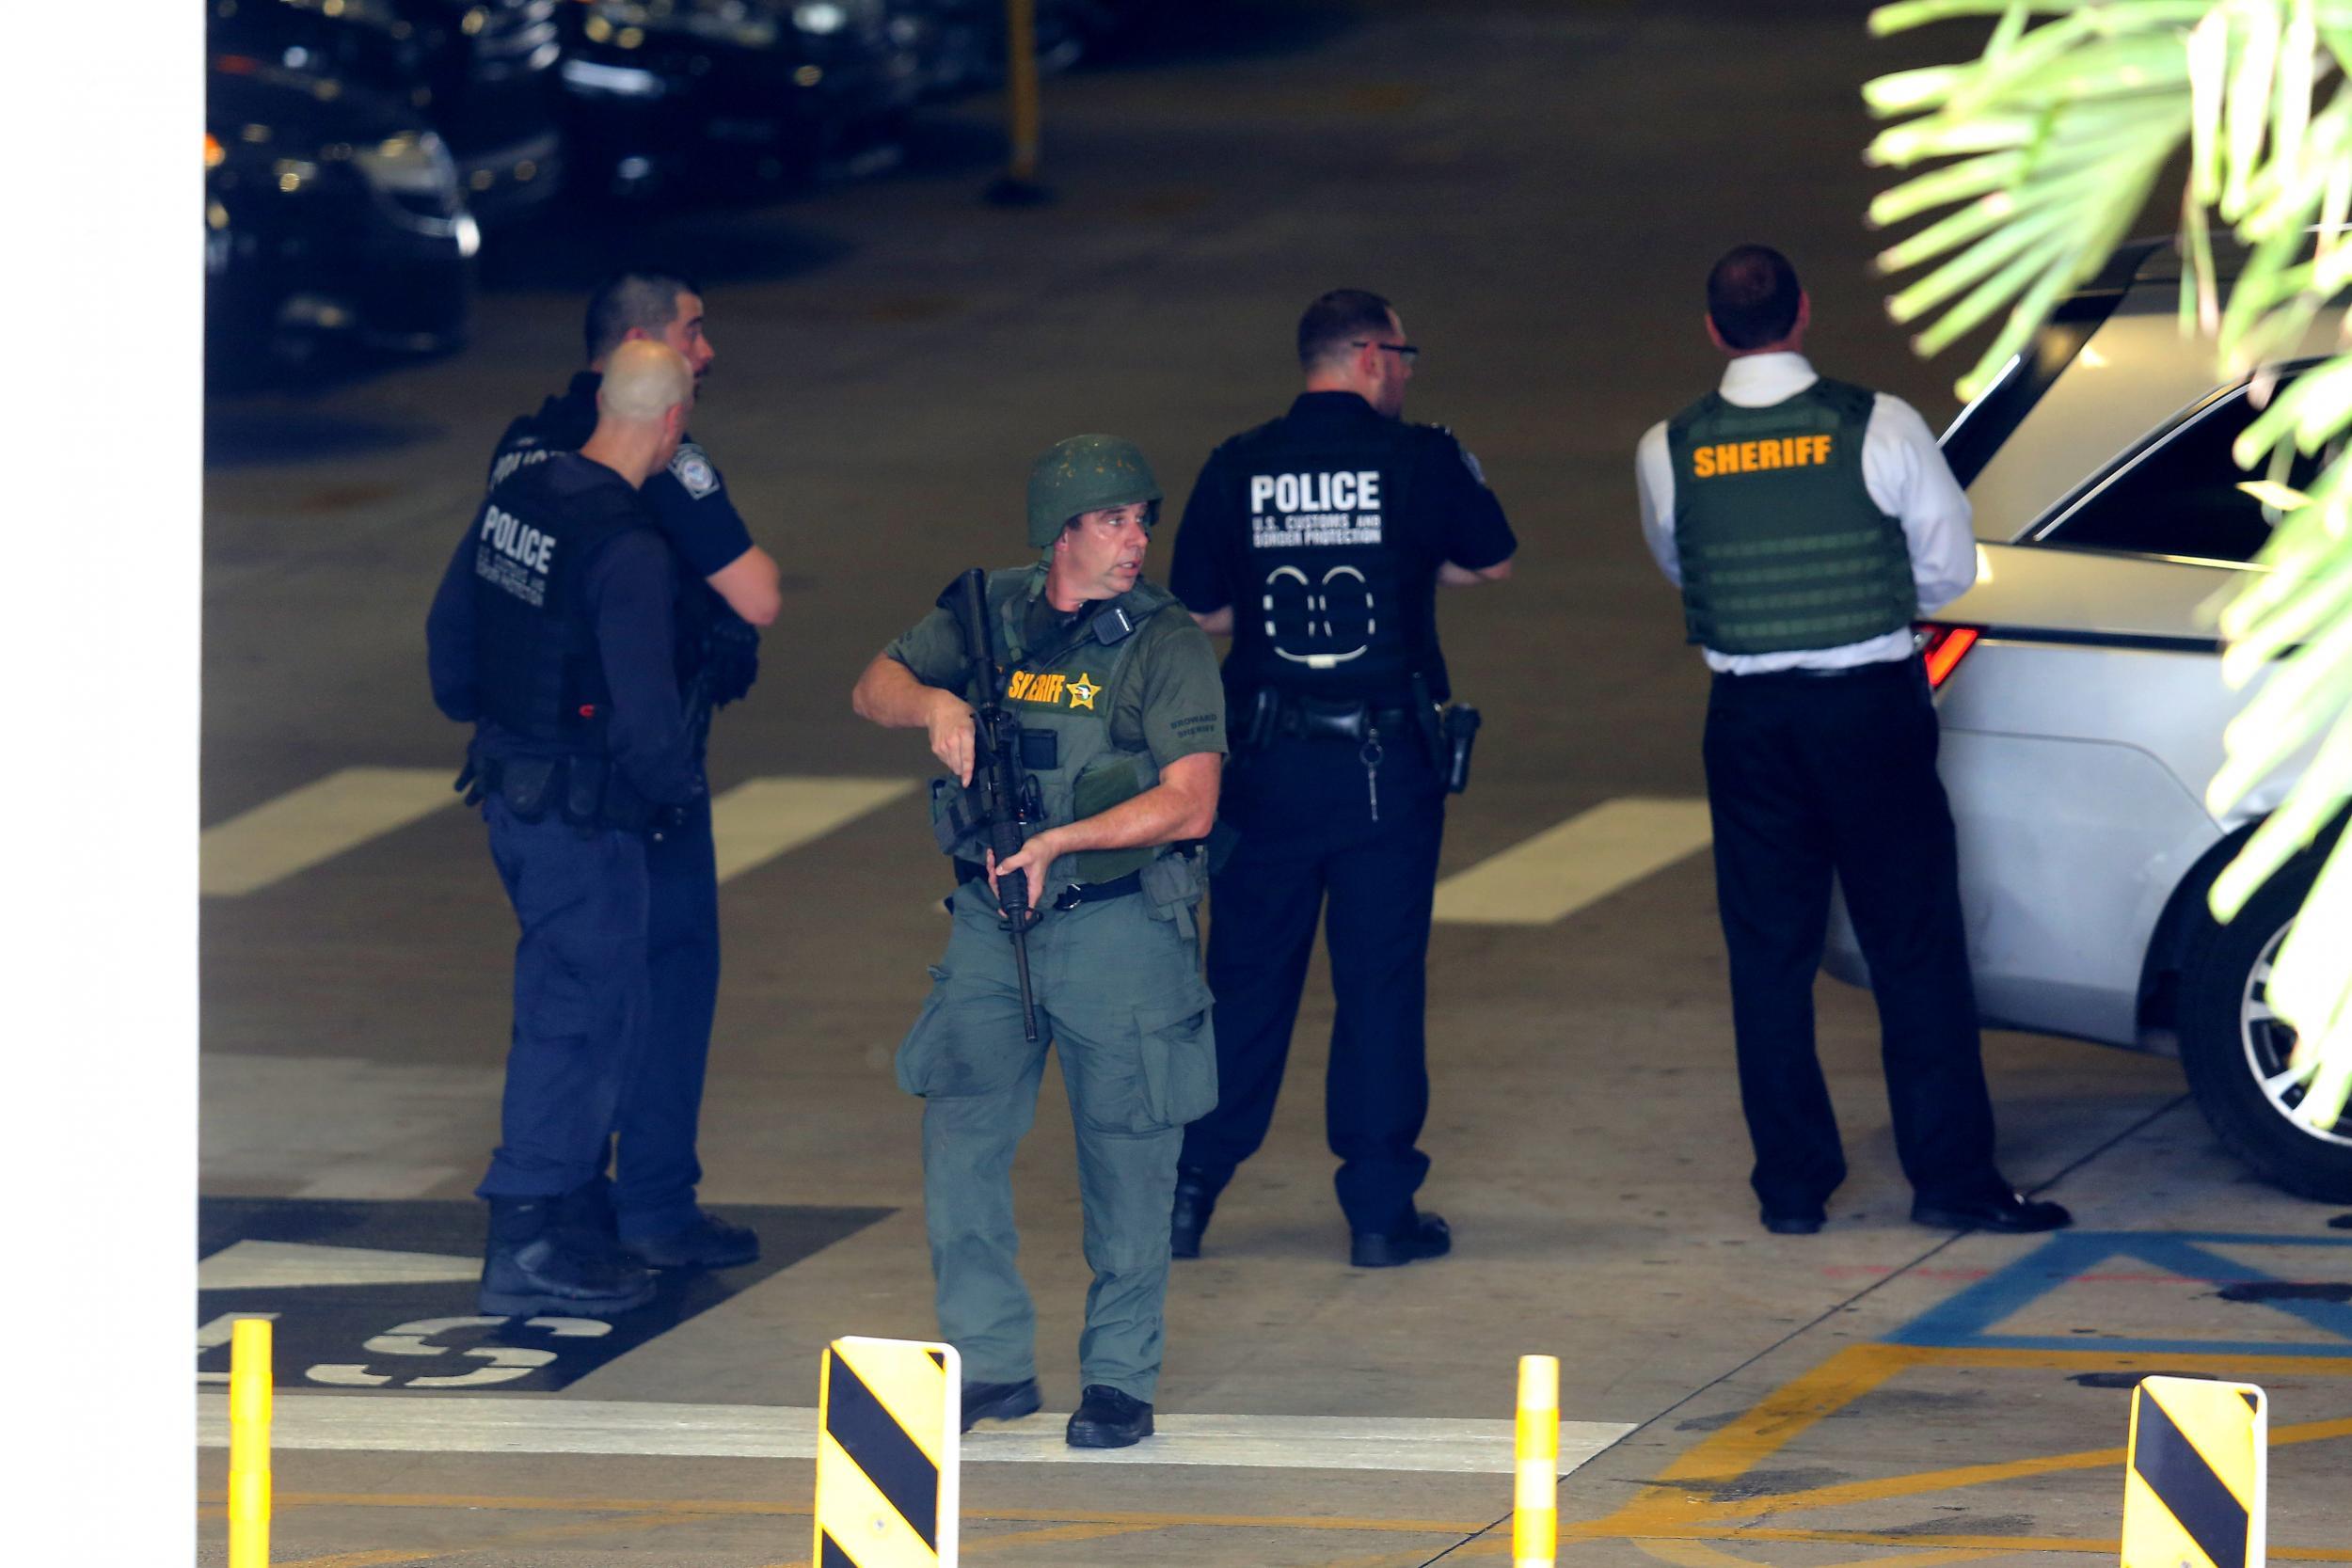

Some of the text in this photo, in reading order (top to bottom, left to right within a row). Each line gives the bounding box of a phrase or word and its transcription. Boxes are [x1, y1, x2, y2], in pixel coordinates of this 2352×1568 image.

[1693, 435, 1832, 478] SHERIFF
[1250, 471, 1381, 514] POLICE
[481, 504, 556, 575] POLICE
[1356, 515, 1381, 528] AND
